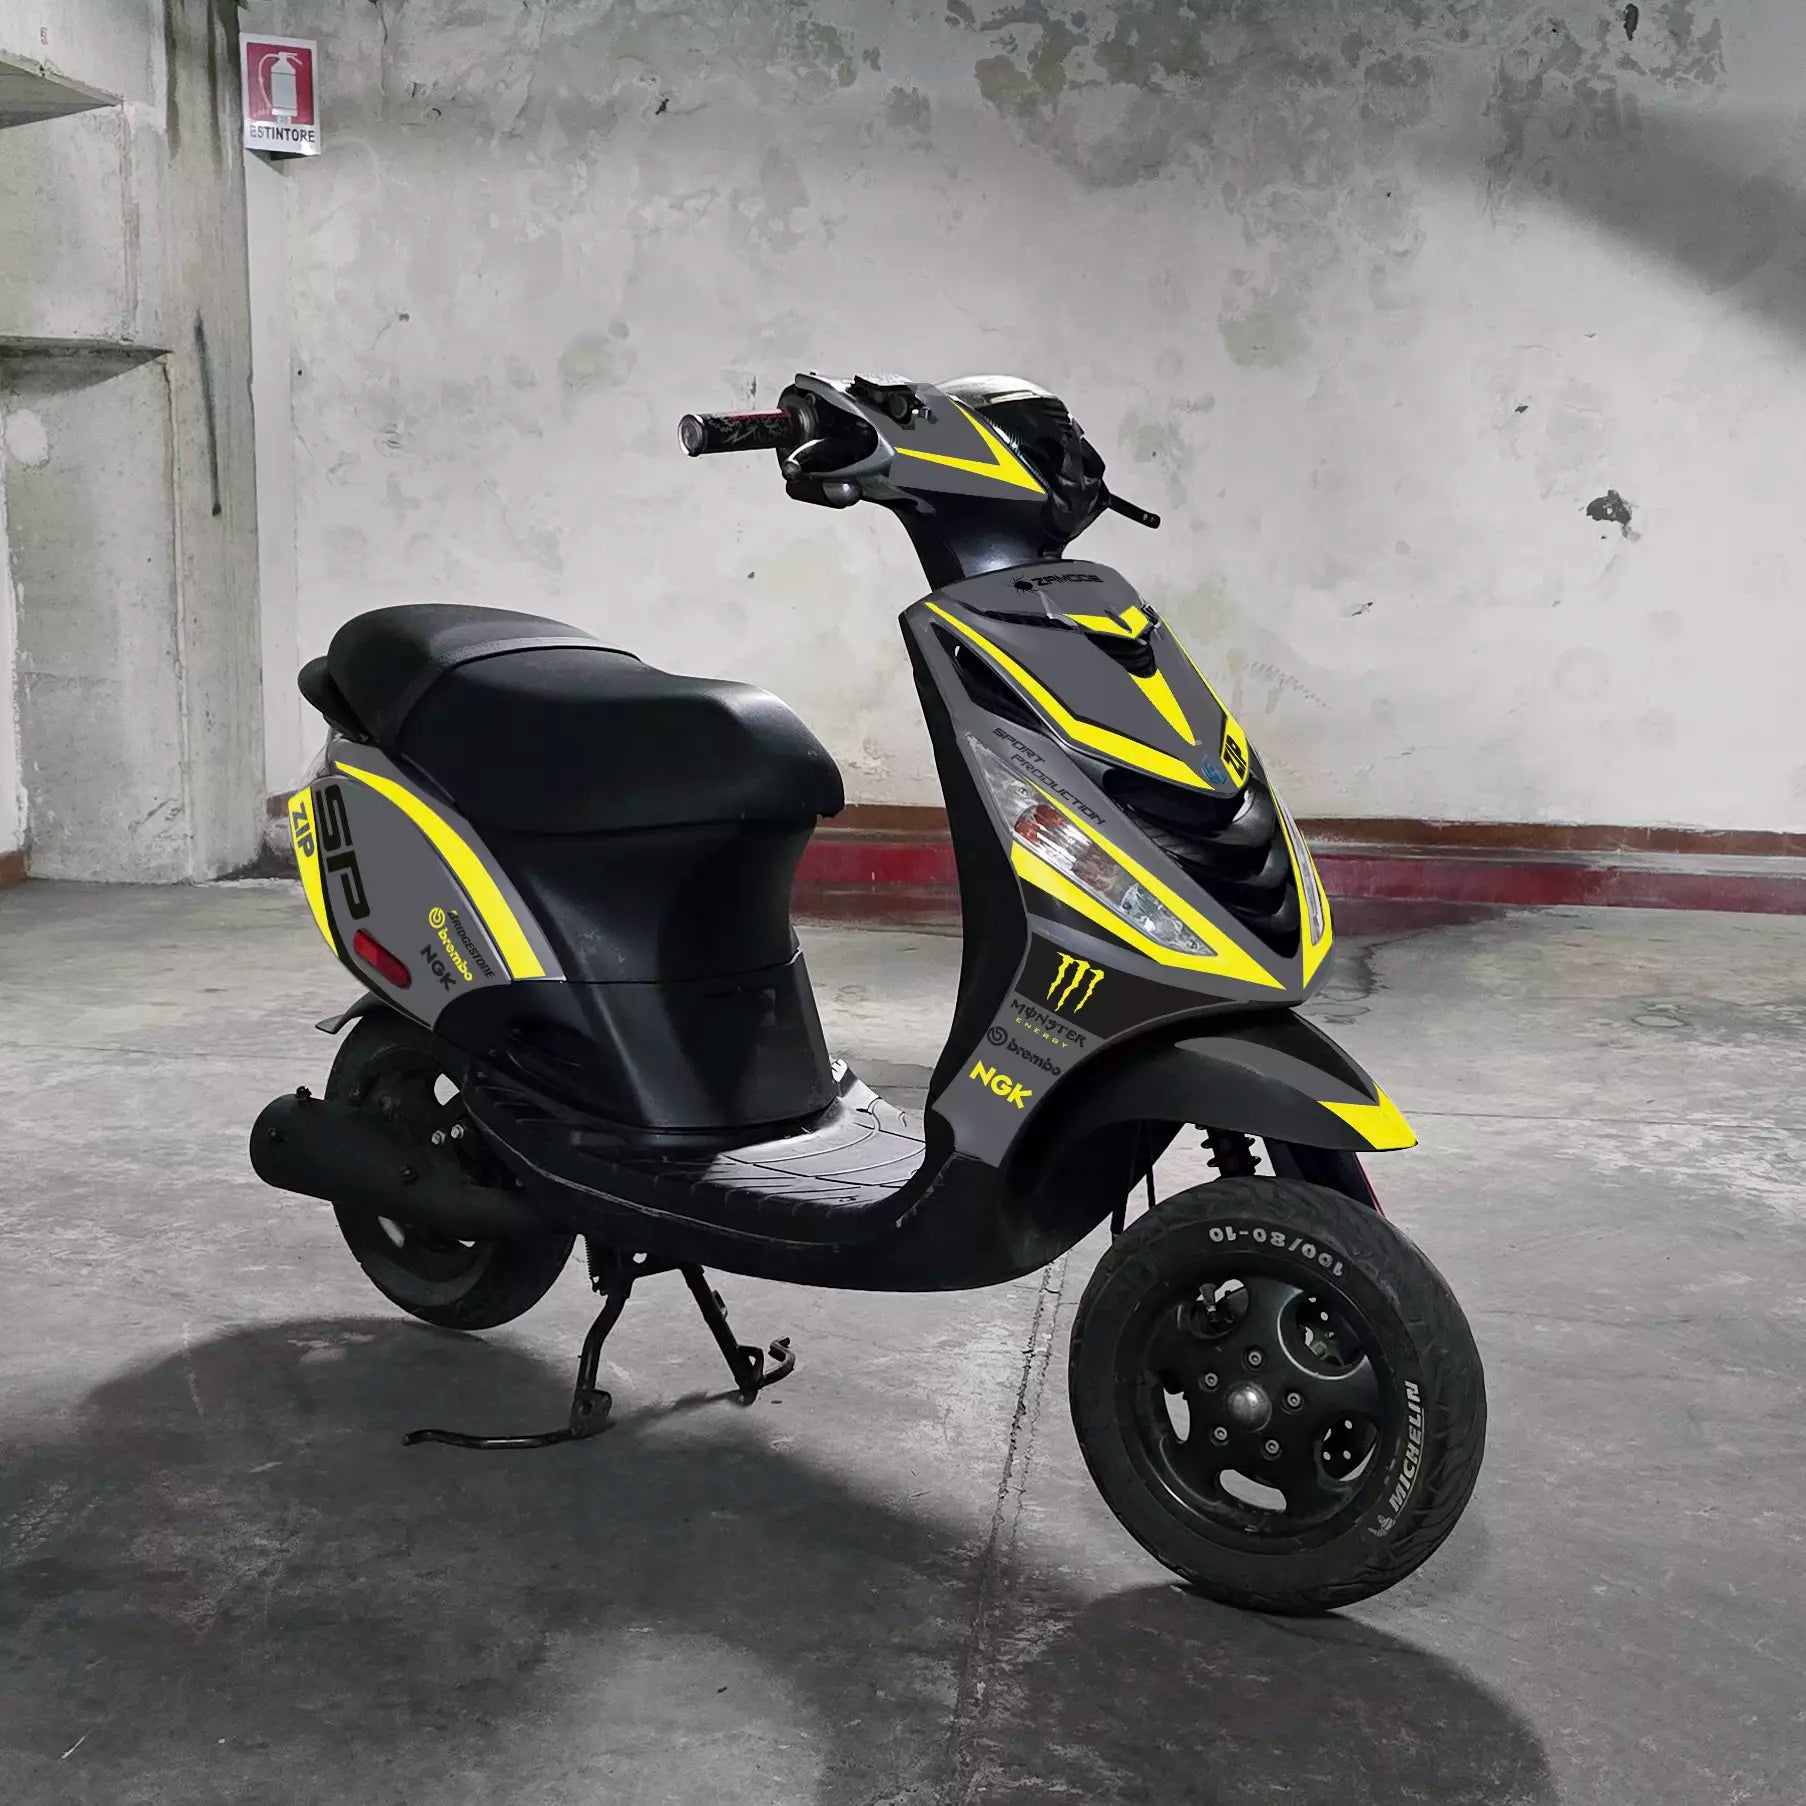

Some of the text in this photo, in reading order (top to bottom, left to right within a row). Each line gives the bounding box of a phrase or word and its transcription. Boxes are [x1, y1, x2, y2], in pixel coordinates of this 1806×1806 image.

[250, 125, 315, 142] ESTINTORE
[992, 727, 1046, 763] SPORT
[1223, 734, 1247, 781] ZIP
[1010, 753, 1106, 825] PRODUCTION
[291, 801, 315, 858] ZIP
[315, 783, 371, 920] SP
[420, 943, 457, 992] NGK
[438, 927, 473, 982] brembo
[1006, 1038, 1062, 1076] brembo
[1015, 1017, 1069, 1049] ENERGY
[969, 1060, 1033, 1109] NGK
[1389, 1380, 1422, 1512] MICHELIN
